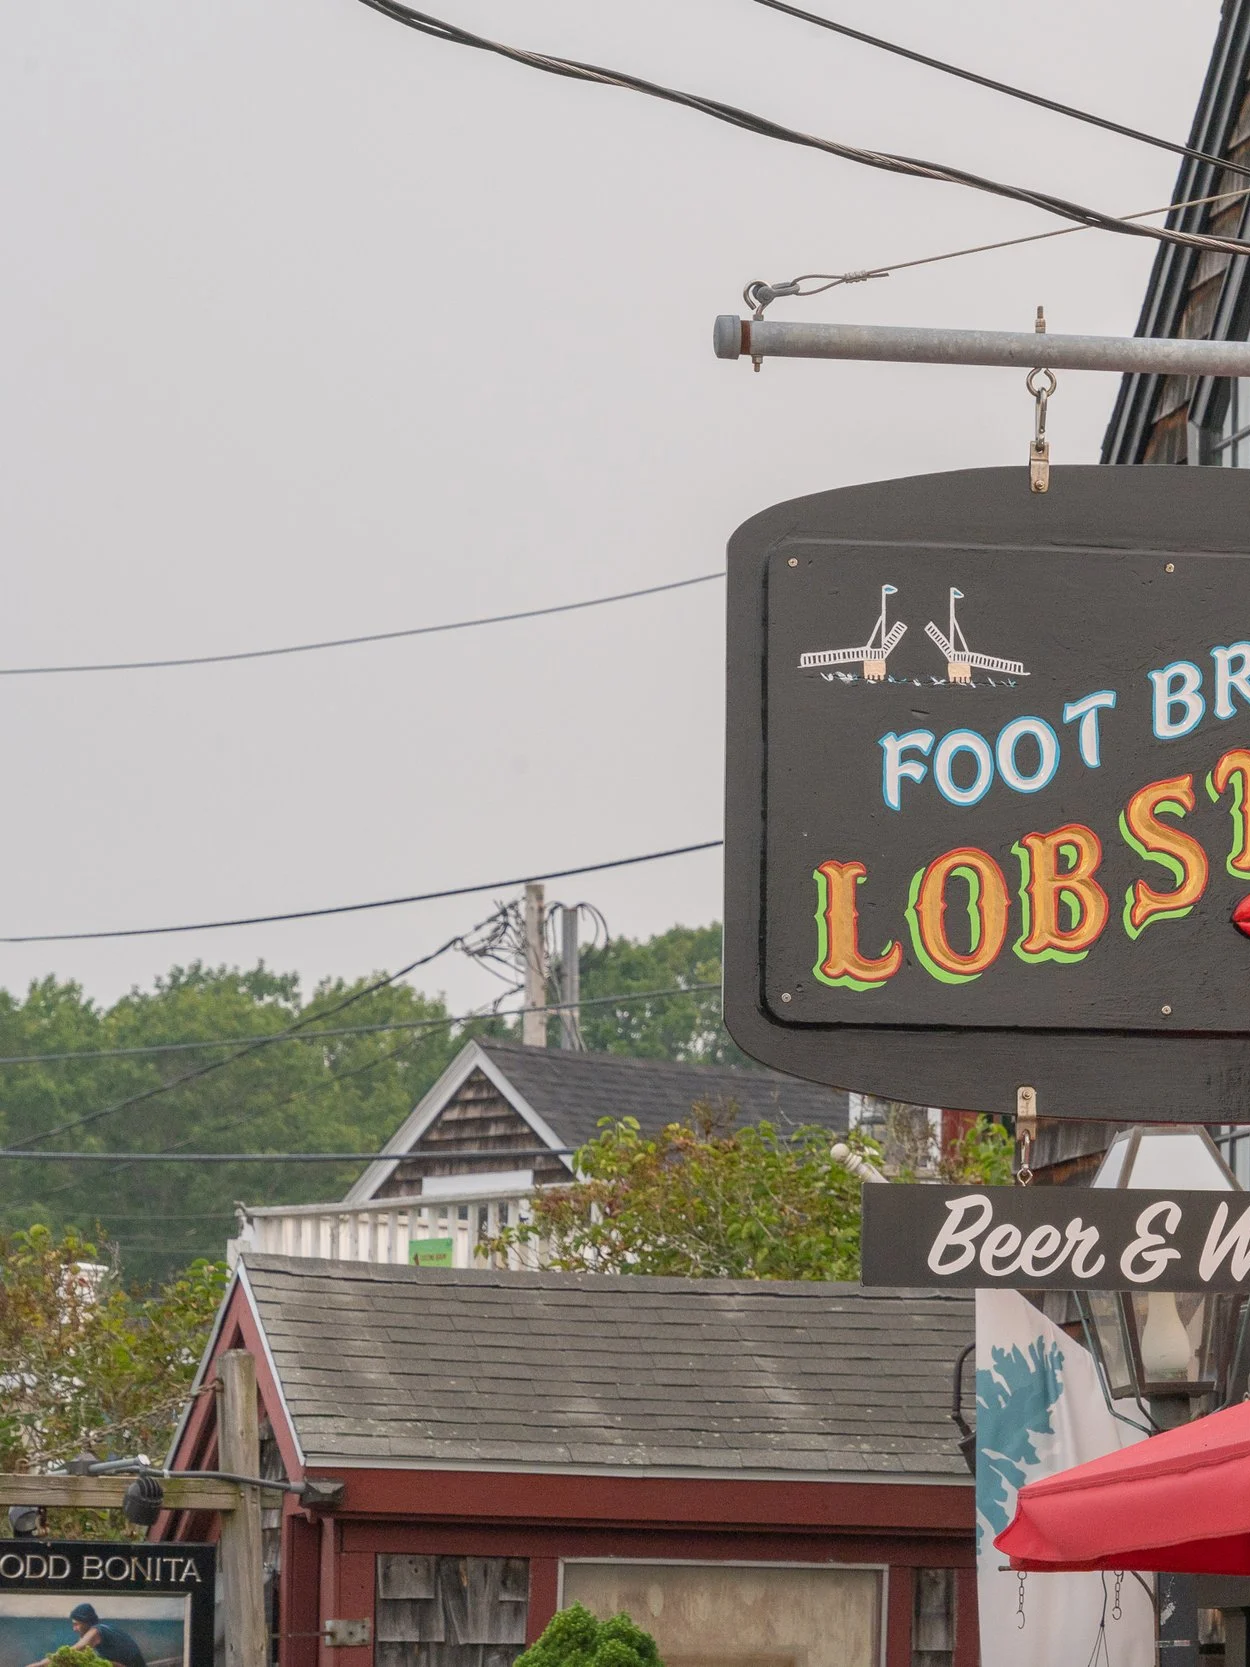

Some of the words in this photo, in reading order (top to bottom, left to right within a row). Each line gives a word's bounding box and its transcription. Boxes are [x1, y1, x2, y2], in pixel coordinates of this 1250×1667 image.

[880, 690, 1117, 811] FOOT
[927, 1193, 1105, 1279] Beer
[1119, 1200, 1182, 1283] &
[82, 1556, 202, 1583] BONITA
